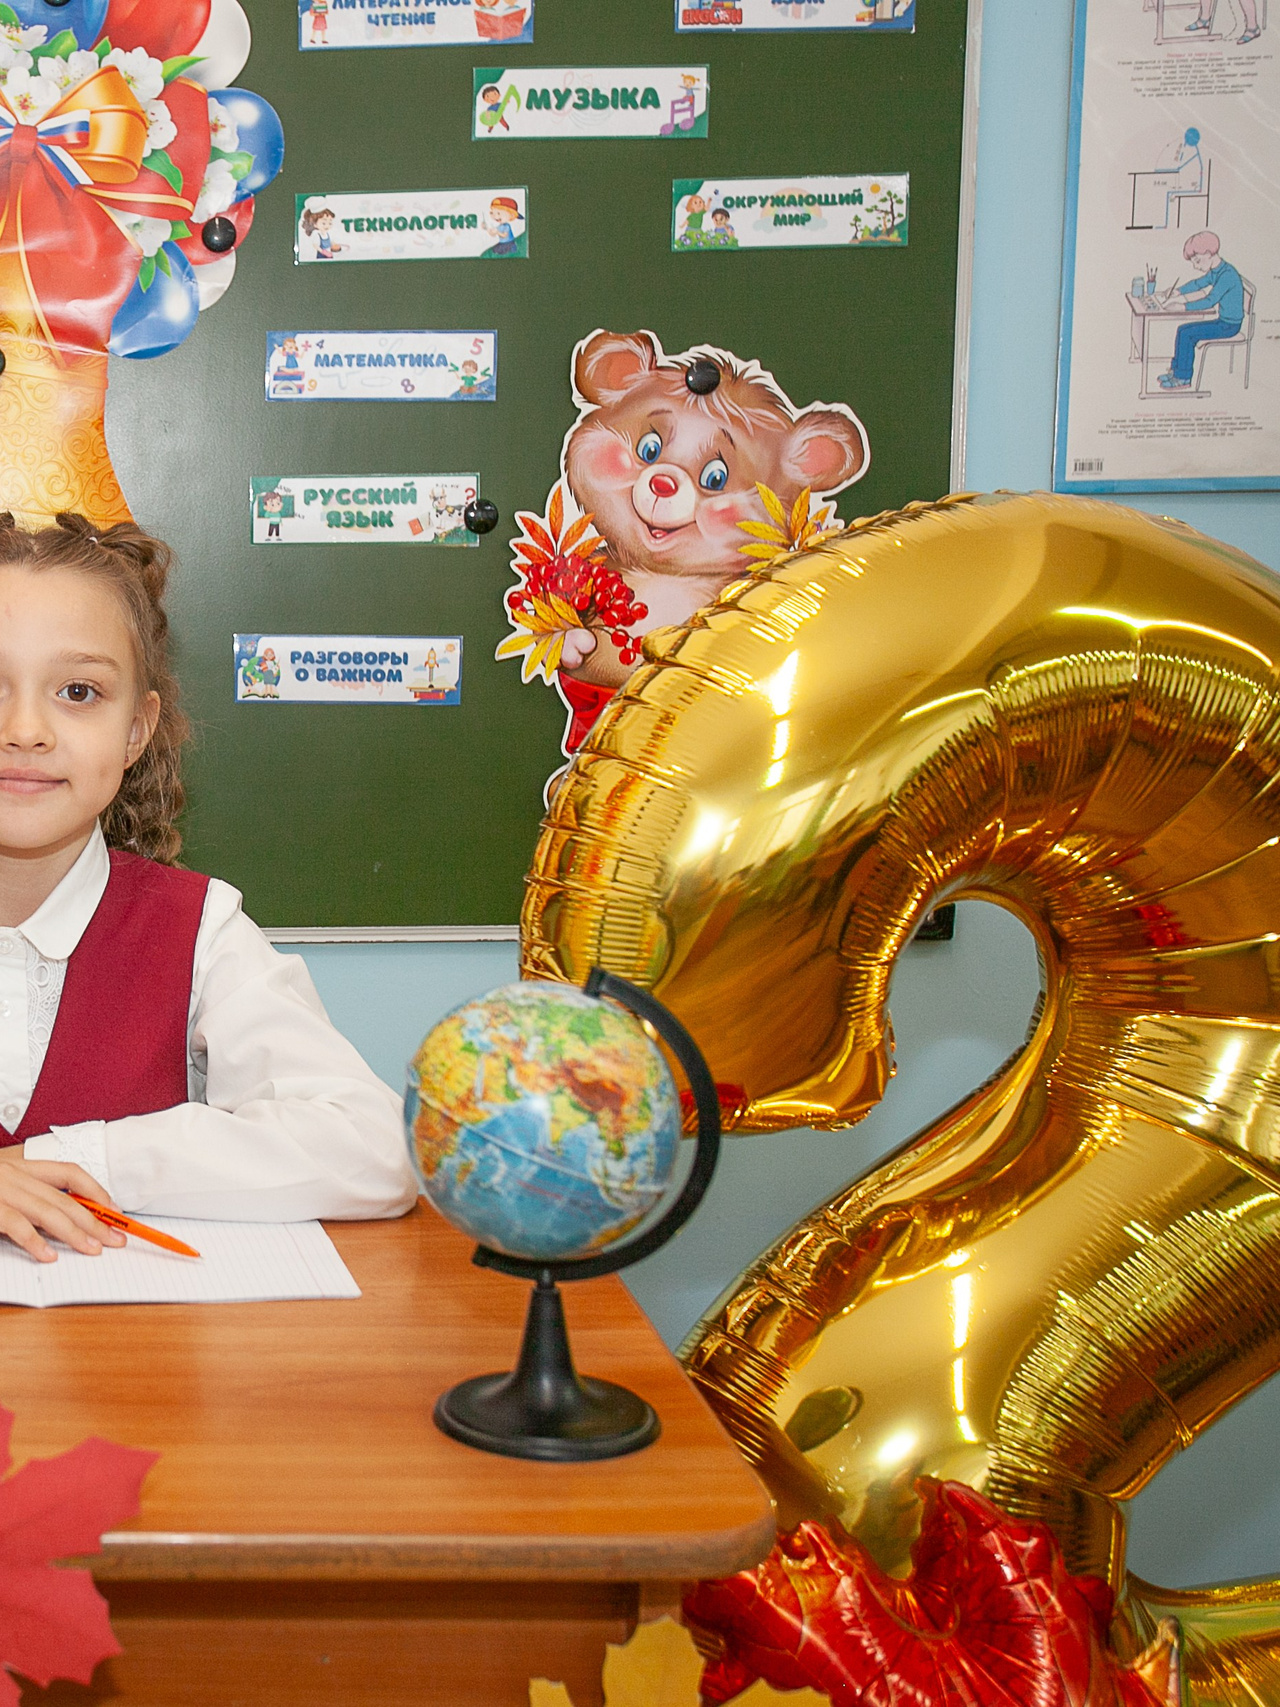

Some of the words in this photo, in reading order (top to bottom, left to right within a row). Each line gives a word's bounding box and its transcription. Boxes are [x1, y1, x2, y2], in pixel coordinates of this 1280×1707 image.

[367, 12, 436, 26] ЧТЕНИЕ
[525, 87, 661, 111] МУЗЫКА
[722, 188, 863, 209] ОКРУЖАЮЩИЙ
[341, 213, 478, 233] ТЕХНОЛОГИЯ
[773, 213, 812, 226] МИР
[314, 353, 448, 368] МАТЕМАТИКА
[303, 481, 418, 506] РУССКИЙ
[326, 510, 394, 528] ЯЗЫК
[290, 651, 409, 665] РАЗГОВОРЫ
[295, 668, 309, 681] О
[316, 668, 403, 682] ВАЖНОМ
